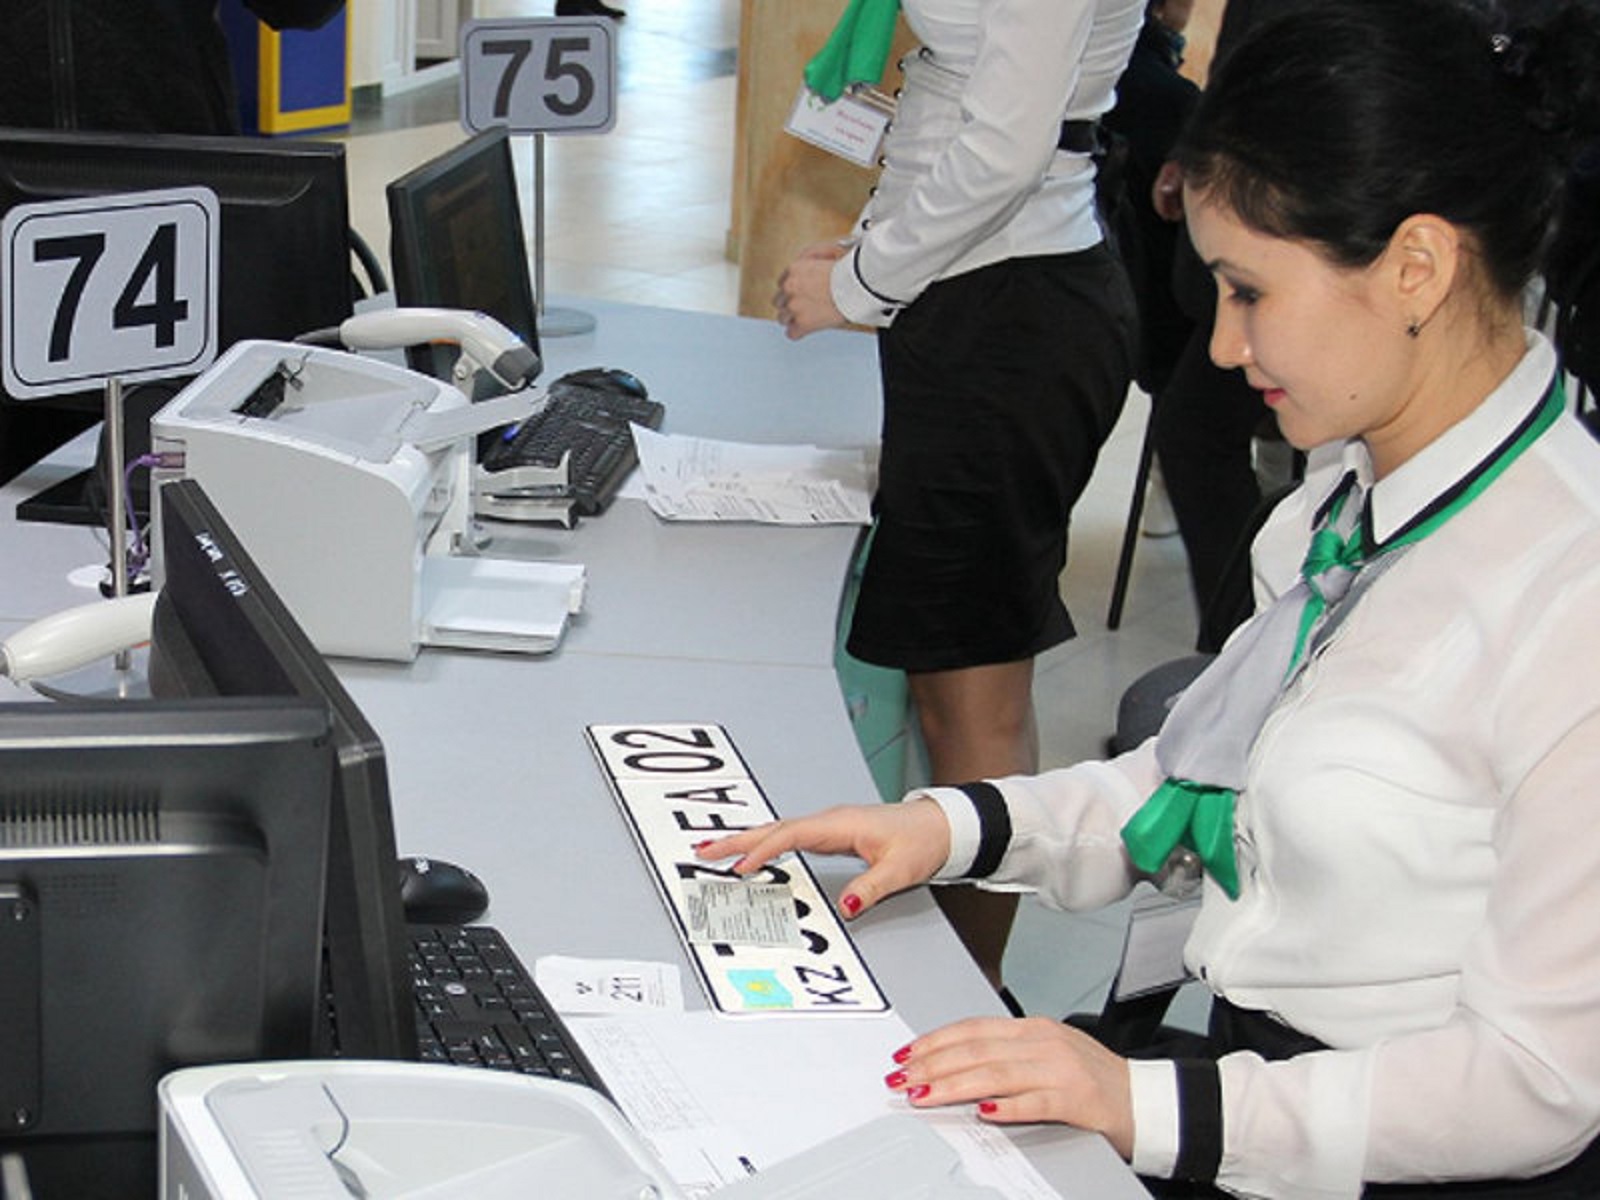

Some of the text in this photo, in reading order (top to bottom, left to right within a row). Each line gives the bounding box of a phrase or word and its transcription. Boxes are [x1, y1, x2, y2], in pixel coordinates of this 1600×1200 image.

[481, 37, 596, 119] 75
[33, 223, 189, 363] 74
[611, 728, 725, 774] 02
[664, 785, 750, 831] FA
[610, 976, 643, 1003] 211
[794, 965, 861, 1006] KZ
